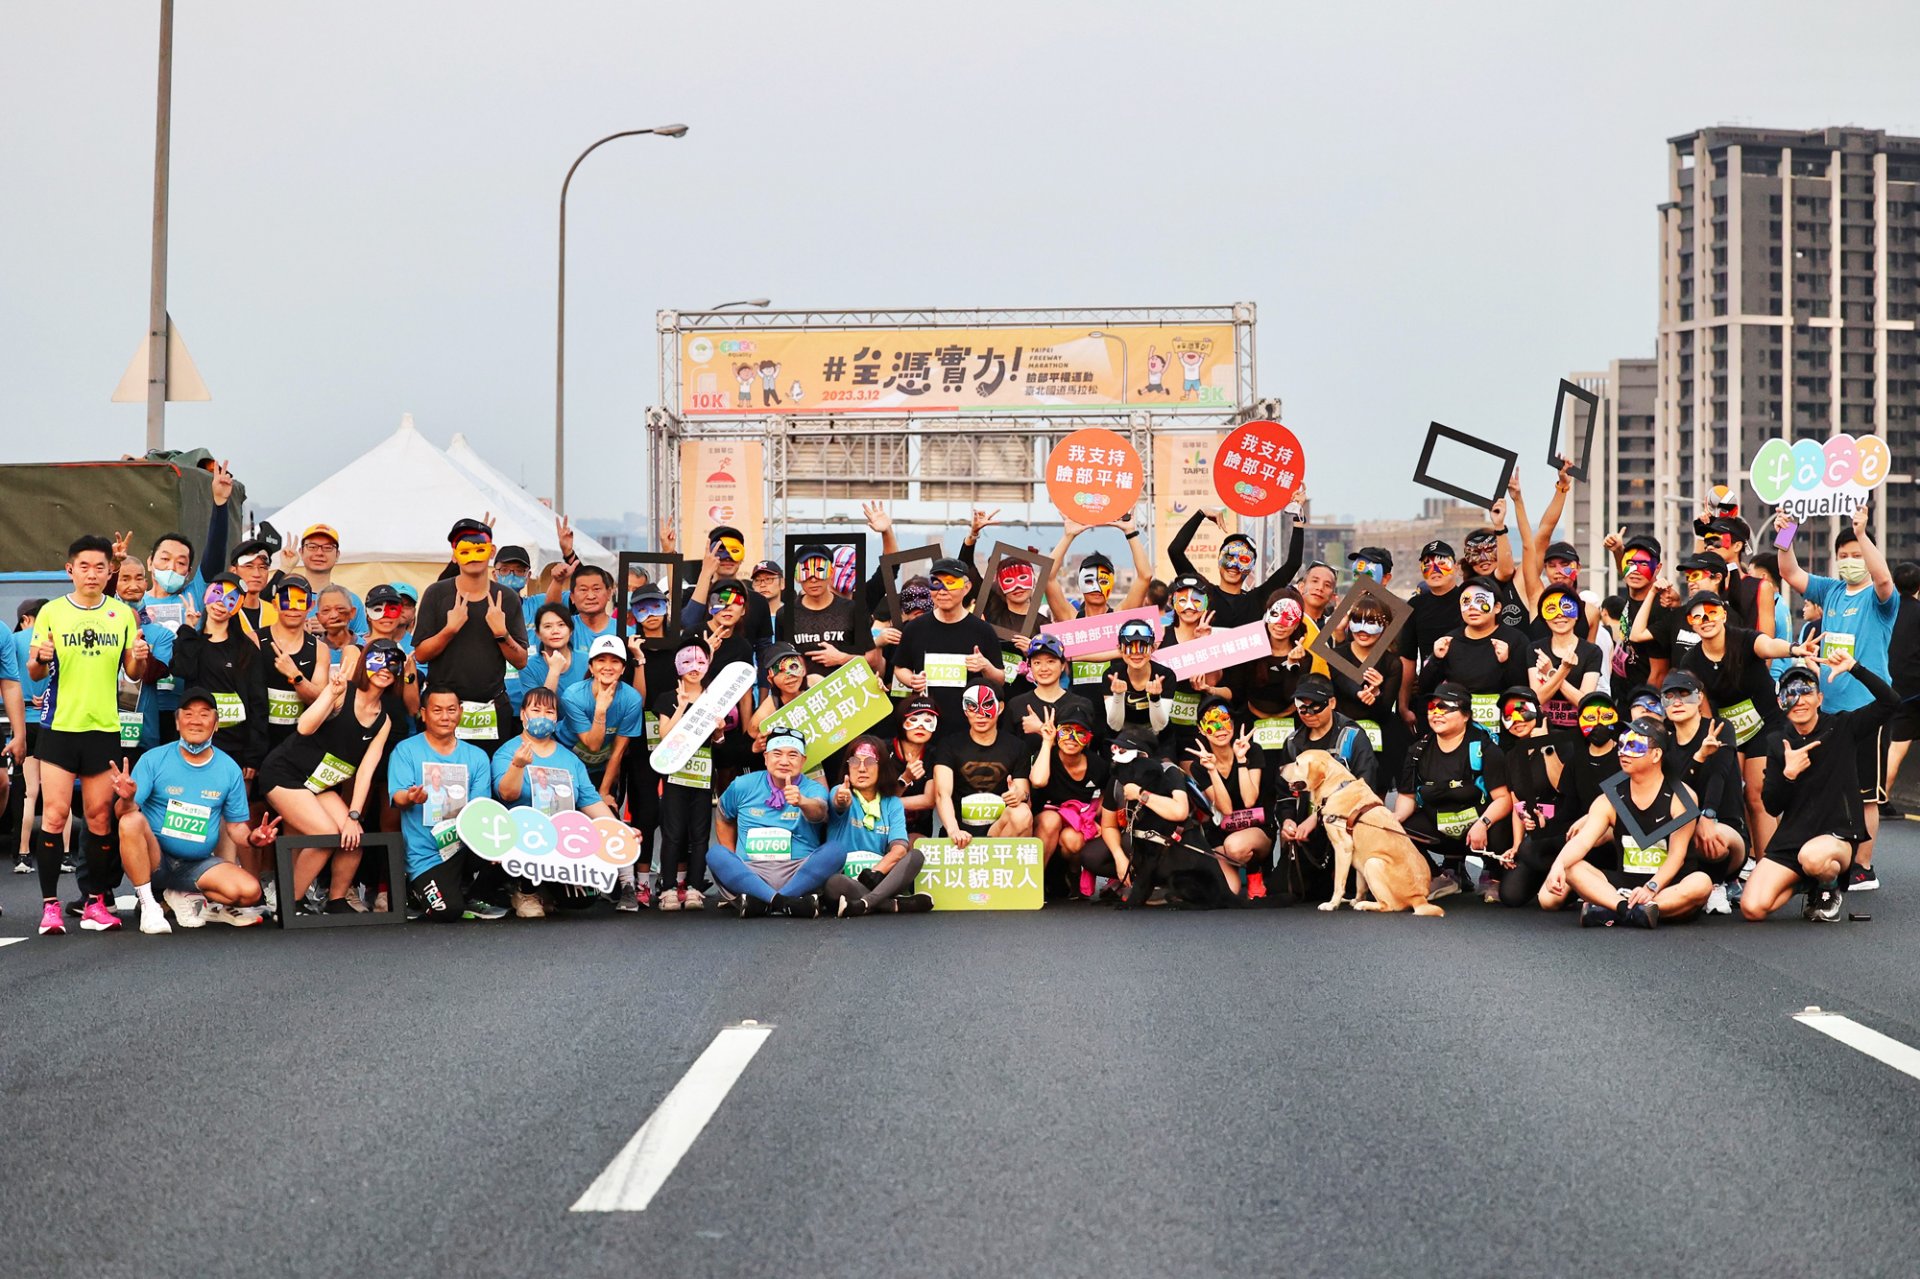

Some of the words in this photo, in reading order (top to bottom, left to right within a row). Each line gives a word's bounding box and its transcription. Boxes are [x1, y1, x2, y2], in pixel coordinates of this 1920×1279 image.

[1026, 371, 1094, 383] 臉部平權運動
[822, 389, 880, 401] 2023.3.12
[1025, 385, 1098, 396] 臺北國道馬拉松
[1199, 386, 1224, 402] 3K
[1068, 445, 1126, 467] 我支持
[1240, 433, 1294, 465] 我支持
[1055, 465, 1134, 489] 臉部平權
[1223, 450, 1295, 490] 臉部平權
[1768, 453, 1880, 490] face
[794, 632, 820, 645] Ultra
[823, 631, 845, 642] 67K
[1162, 634, 1263, 671] 造臉部平權環境
[1077, 664, 1105, 676] 7137
[269, 703, 299, 716] 7139
[463, 714, 492, 726] 7128
[120, 727, 140, 738] 53
[1258, 730, 1288, 742] 8847
[968, 806, 999, 817] 7127
[167, 814, 206, 833] 10727
[481, 814, 627, 860] face
[749, 839, 788, 851] 10760
[920, 844, 1038, 865] 挺臉部平權
[1629, 851, 1661, 865] 7136
[507, 858, 615, 891] equality
[920, 868, 1038, 889] 不以貌取人
